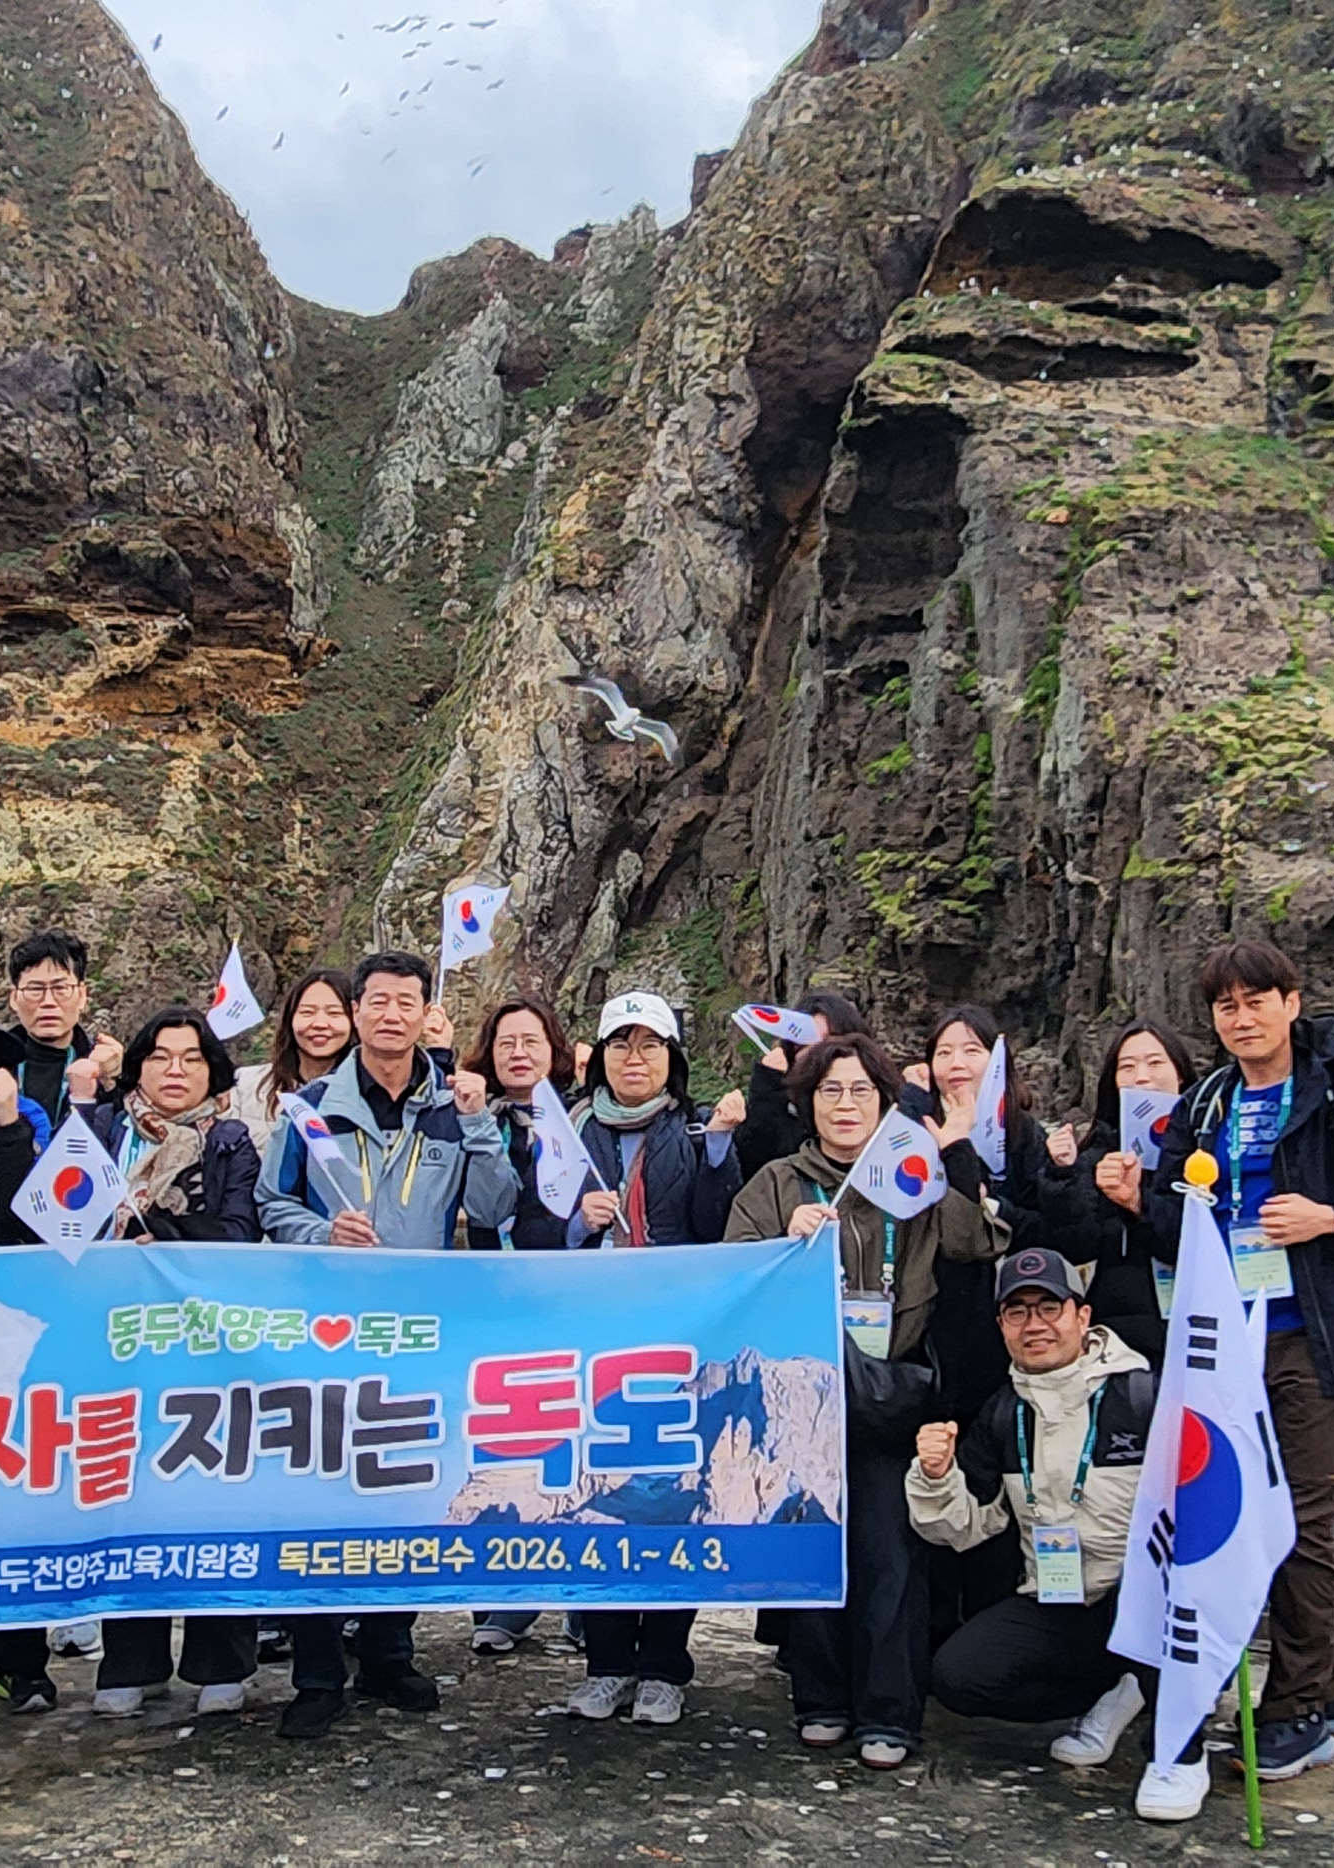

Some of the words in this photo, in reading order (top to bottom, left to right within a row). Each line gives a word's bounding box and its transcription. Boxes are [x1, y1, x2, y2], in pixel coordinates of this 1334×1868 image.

[625, 999, 644, 1014] LA
[110, 1300, 307, 1358] 동두천양주
[356, 1314, 440, 1355] 독도
[157, 1378, 438, 1491] 지키는
[464, 1347, 699, 1490] 독도
[278, 1537, 475, 1577] 독도탐방연수
[486, 1537, 572, 1571] 2026.
[579, 1537, 607, 1571] 4.
[669, 1538, 696, 1571] 4.
[702, 1537, 730, 1571] 3.
